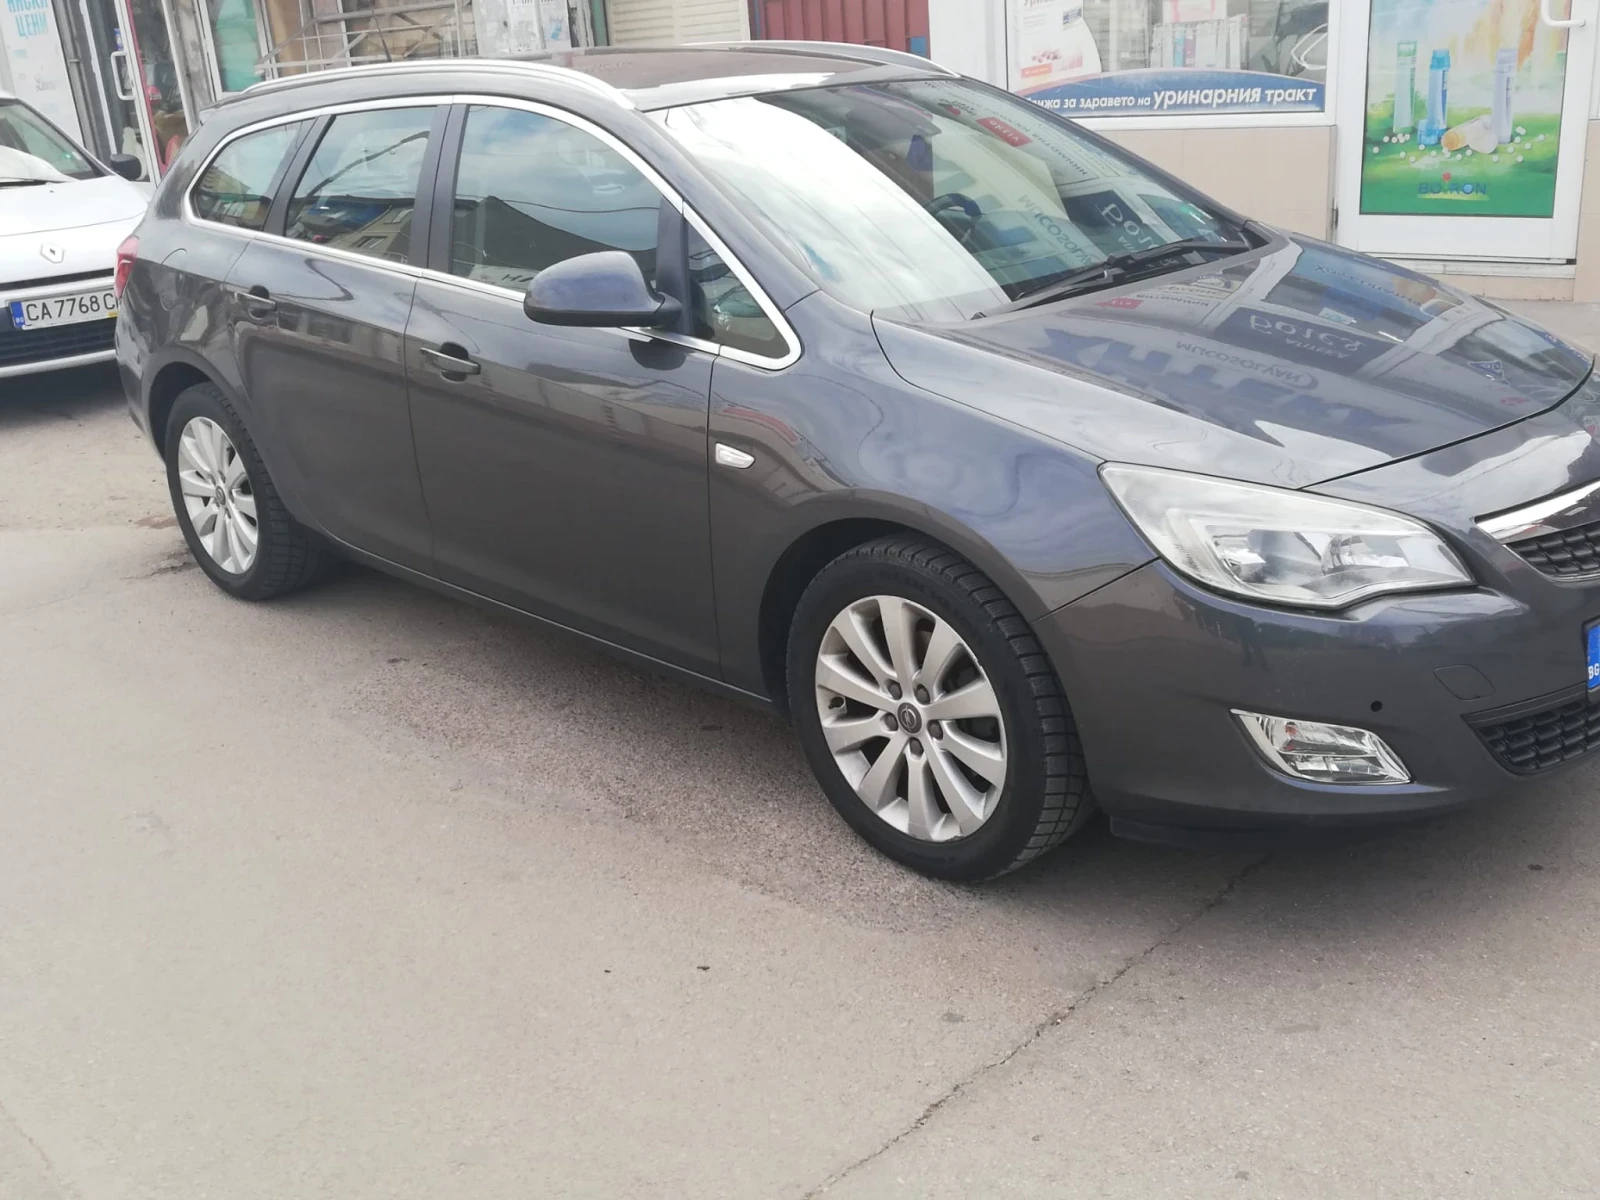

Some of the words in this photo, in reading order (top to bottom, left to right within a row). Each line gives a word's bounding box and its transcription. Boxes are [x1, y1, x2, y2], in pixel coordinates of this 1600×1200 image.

[15, 12, 47, 37] ЦЕНИ
[1063, 98, 1076, 109] за
[1079, 96, 1135, 110] здравето
[1137, 96, 1151, 107] на
[1152, 88, 1261, 111] уринарния
[1265, 86, 1317, 107] тракт
[26, 302, 52, 321] CA
[54, 295, 100, 318] 7768
[1587, 663, 1600, 680] BG
